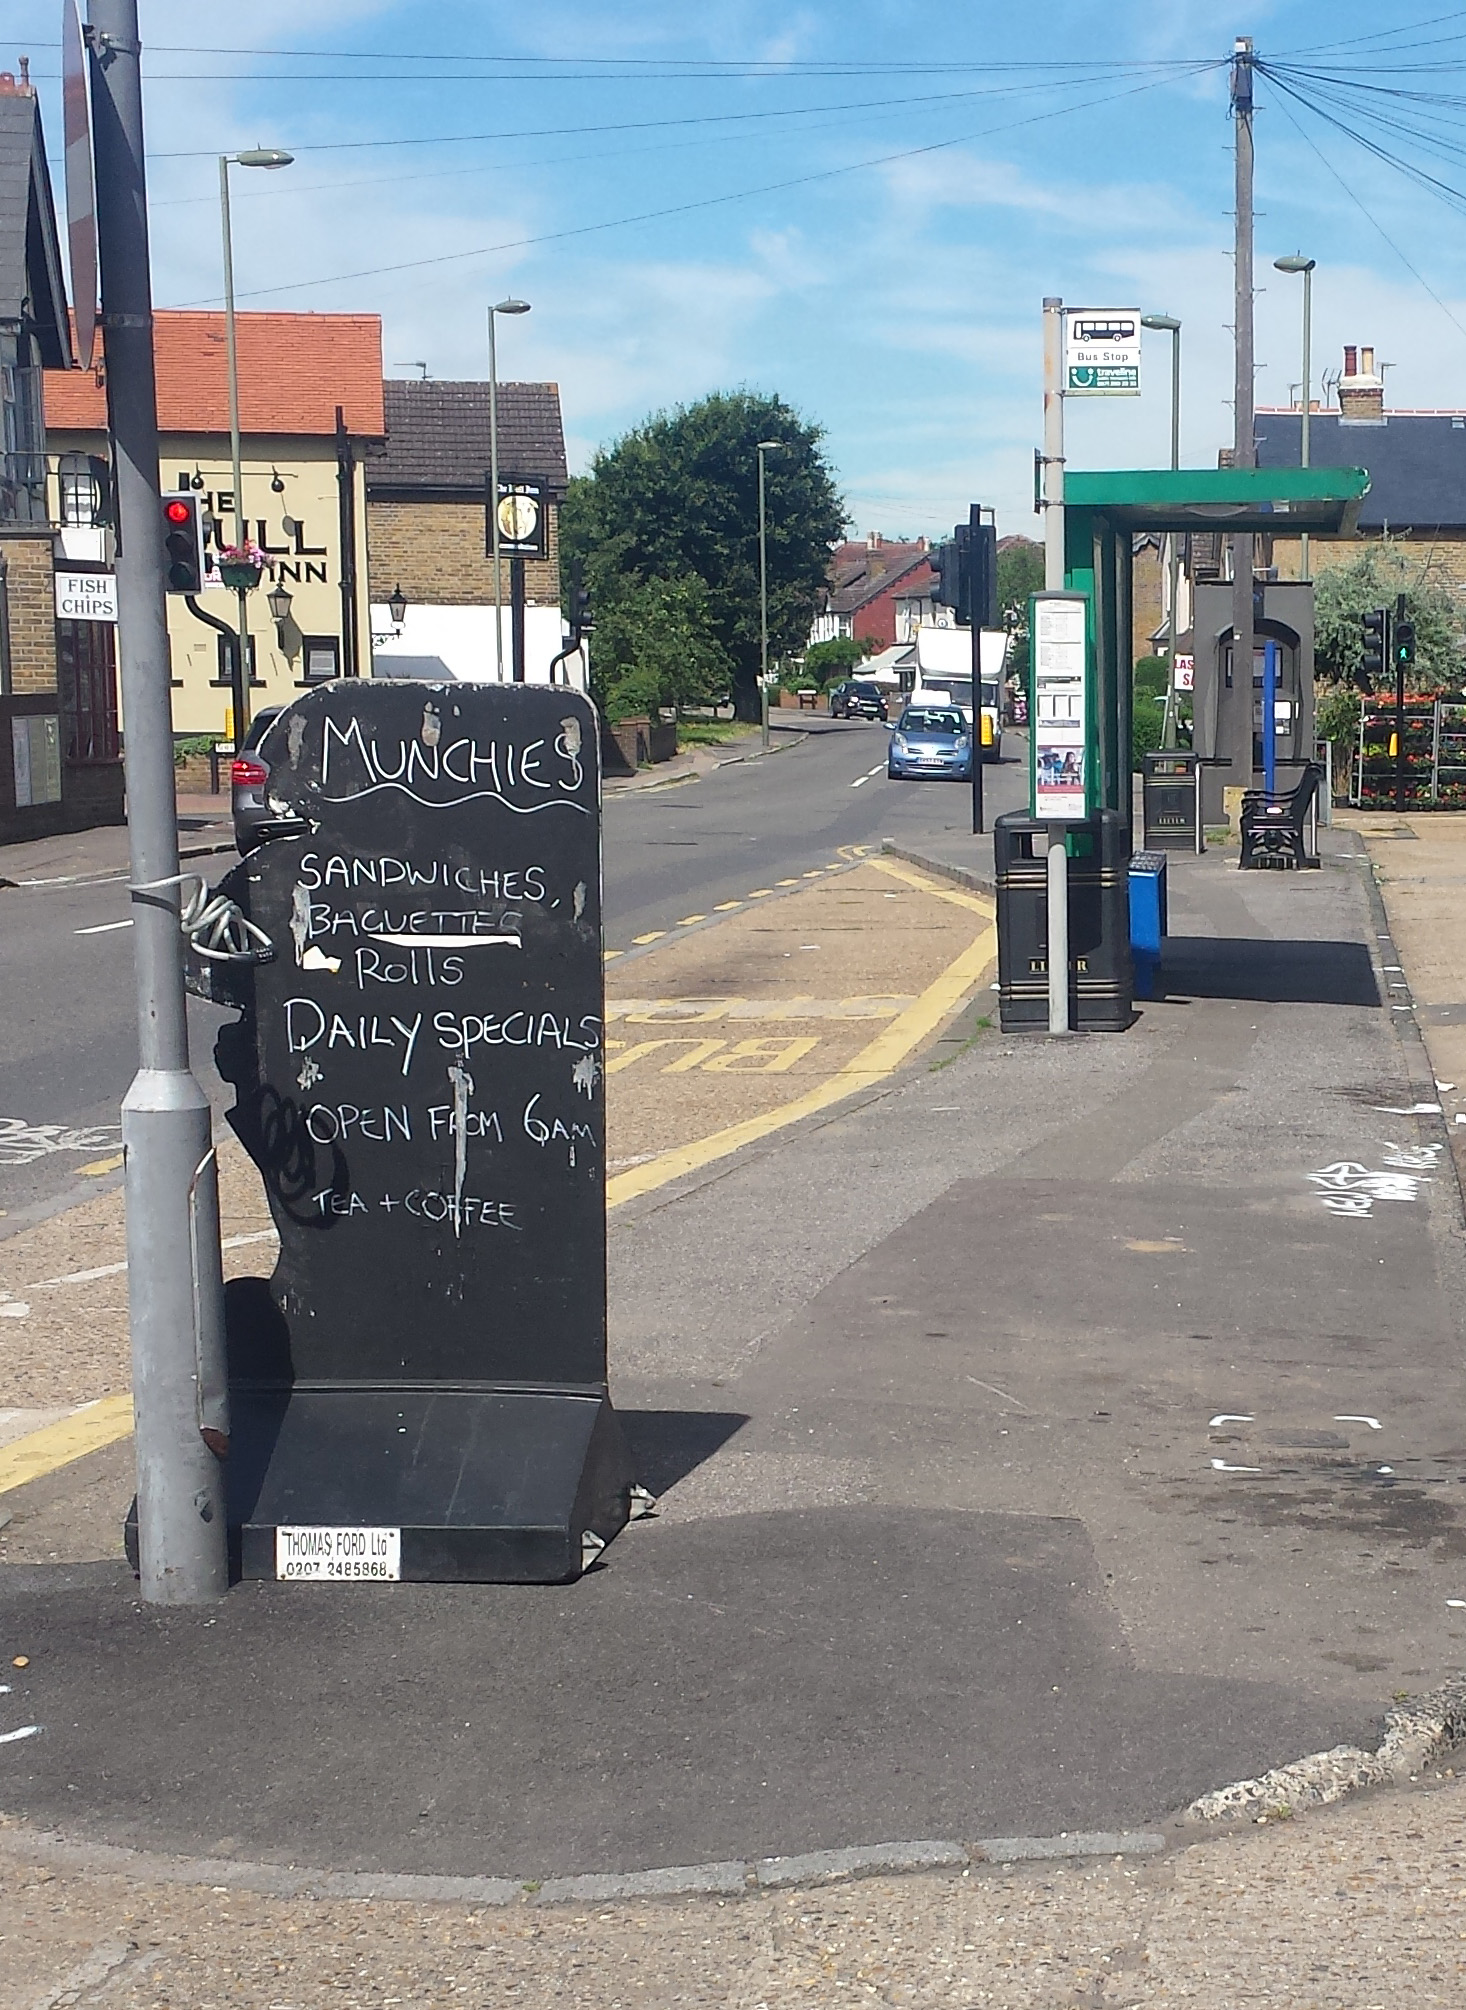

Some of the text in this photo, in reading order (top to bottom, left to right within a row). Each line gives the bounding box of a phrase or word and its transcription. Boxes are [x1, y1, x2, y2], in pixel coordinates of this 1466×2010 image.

[1077, 352, 1129, 363] Bus Stop
[213, 518, 328, 556] ULL
[68, 578, 108, 594] FISH
[62, 598, 114, 615] CHIPS
[1173, 659, 1195, 670] LAS
[321, 715, 585, 792] MUNCHIES
[307, 904, 524, 940] BAGUETTES
[283, 997, 602, 1076] DAILY SPECIALS
[306, 1103, 412, 1144] OPEN
[312, 1187, 369, 1218] TEA
[404, 1188, 524, 1231] COFFEE
[287, 1531, 333, 1557] THOMAS
[336, 1532, 366, 1556] FORD
